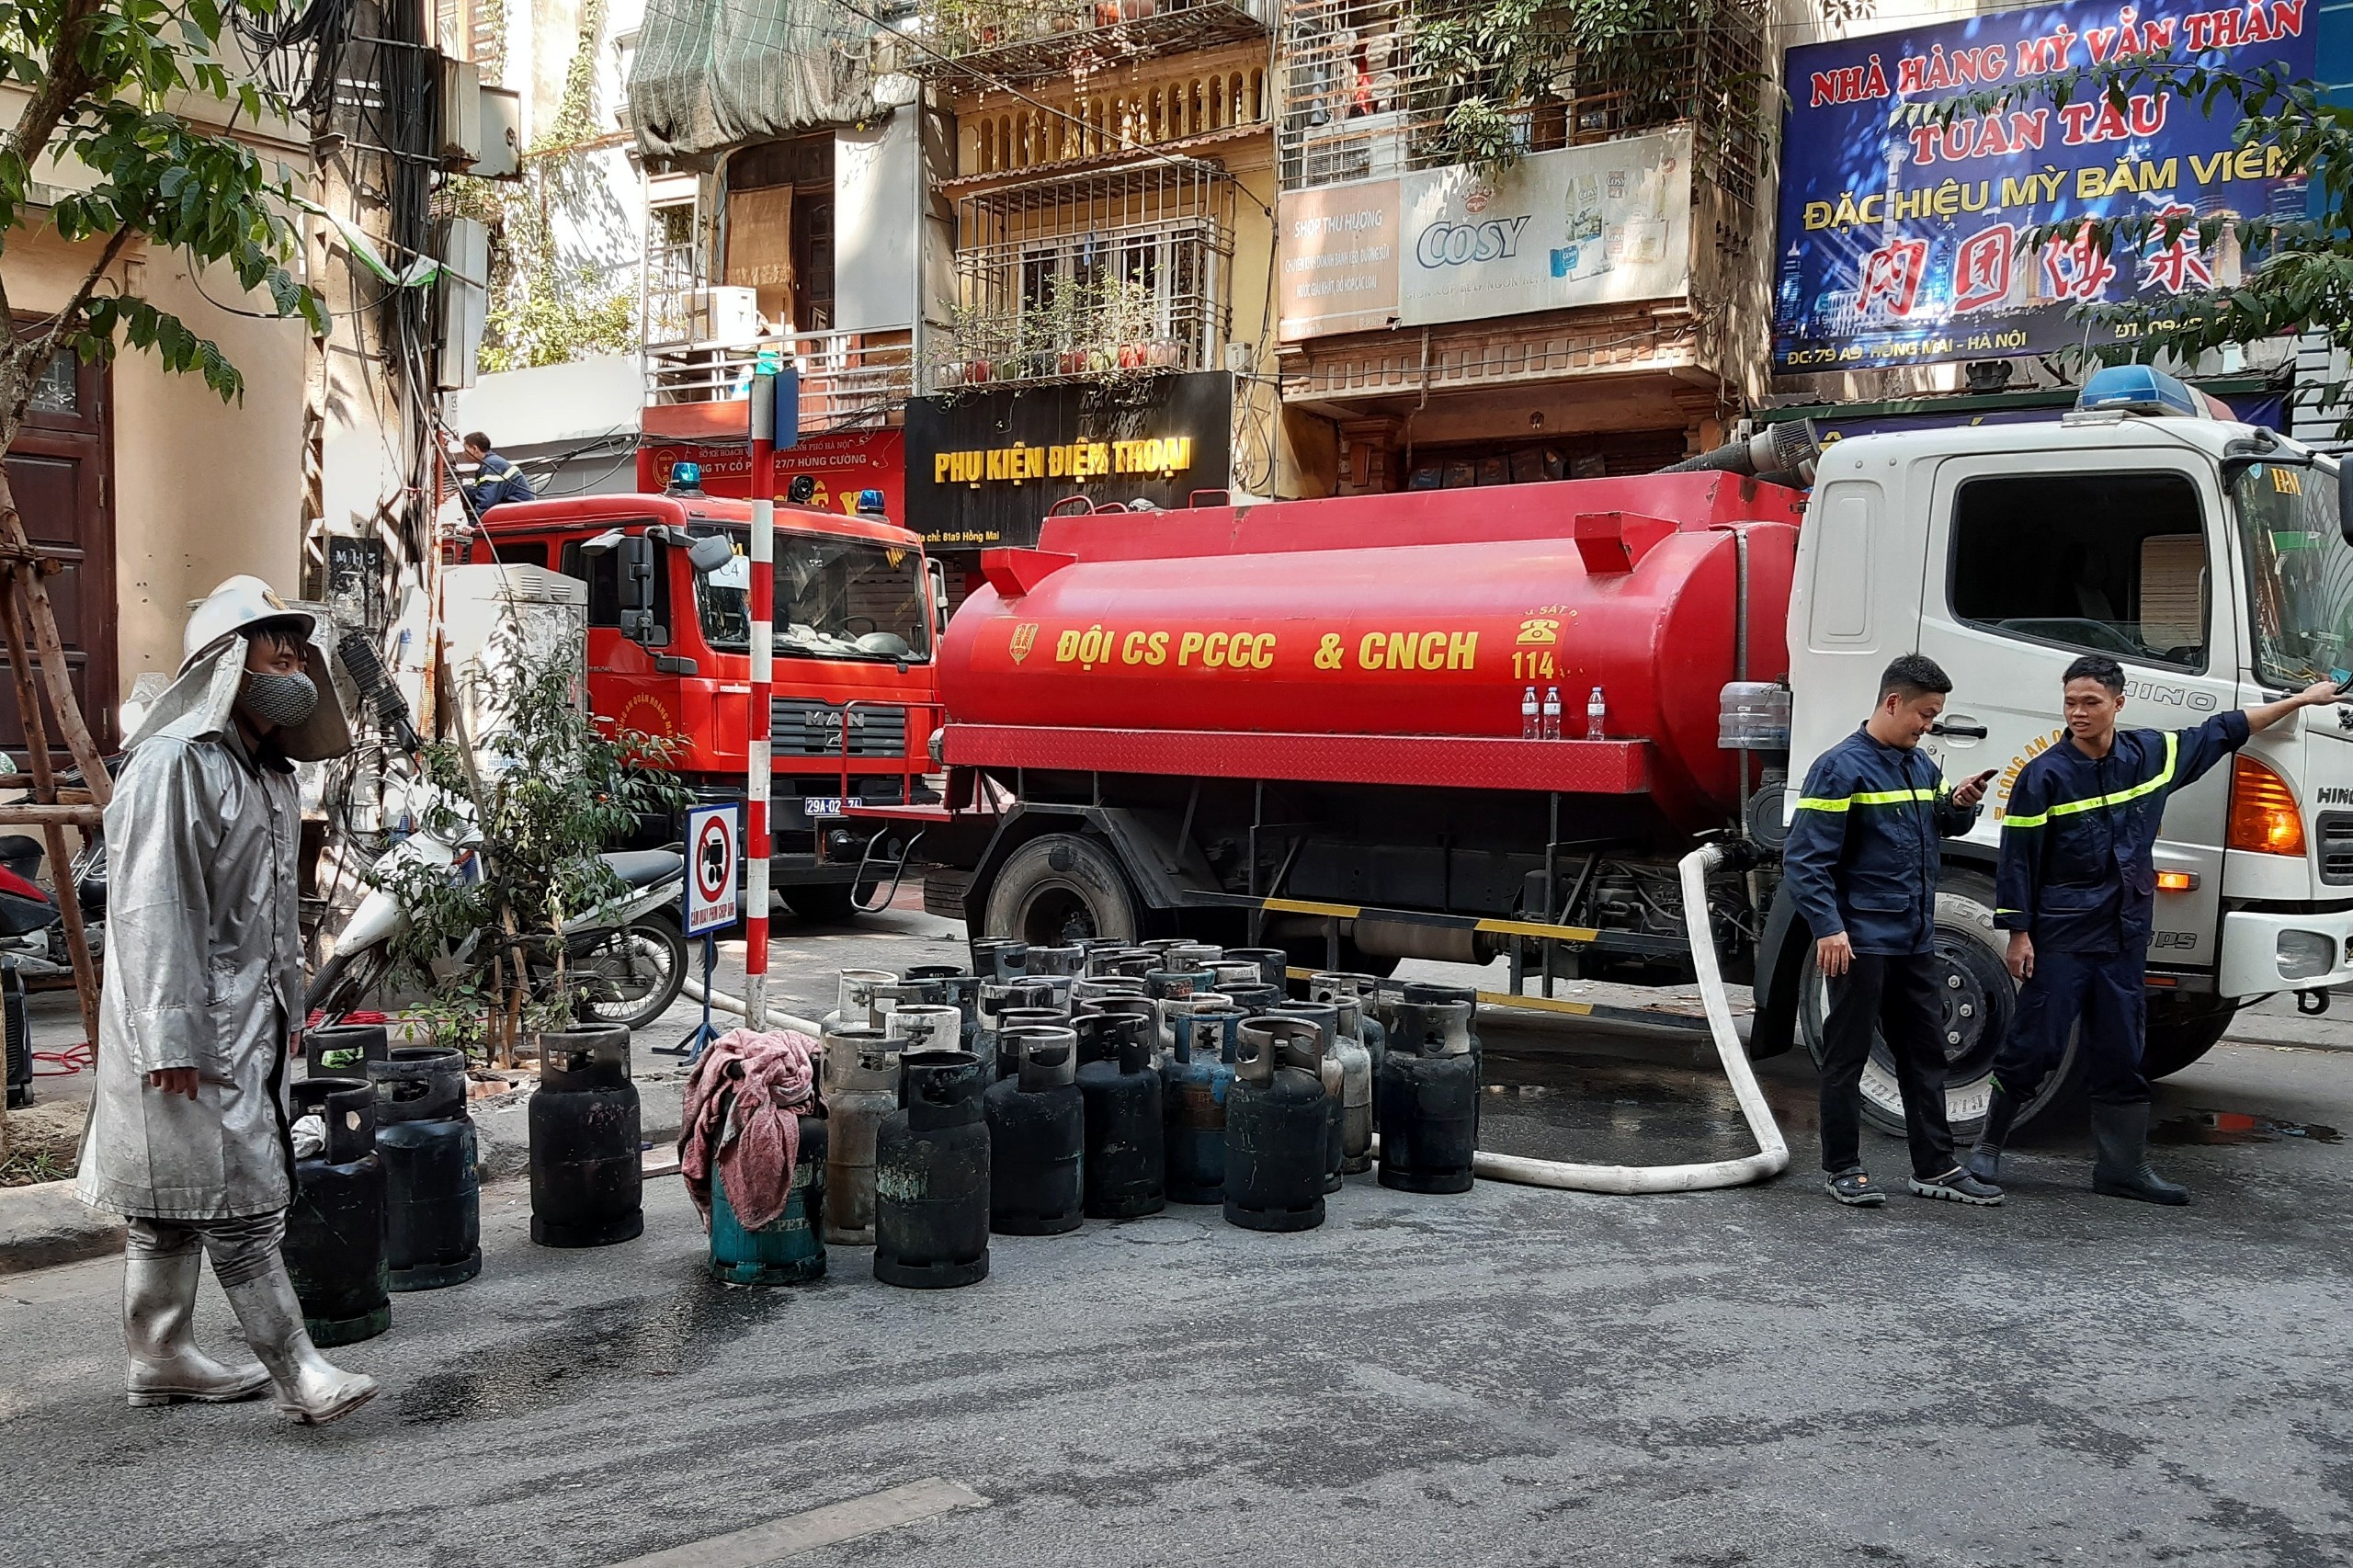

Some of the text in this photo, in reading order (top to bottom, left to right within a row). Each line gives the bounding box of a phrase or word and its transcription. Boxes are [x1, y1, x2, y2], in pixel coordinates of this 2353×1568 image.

[1810, 53, 1890, 108] NHÀ
[1897, 43, 2008, 94] HÀNG
[1802, 190, 1885, 235] ĐẶC
[1893, 177, 1991, 222] HIỆU
[1294, 216, 1322, 238] SHOP
[1322, 215, 1343, 234] THU
[1416, 215, 1532, 269] COSY
[1967, 334, 1993, 351] HÀ
[1995, 329, 2028, 350] NỘI
[714, 462, 727, 472] TY
[775, 453, 868, 470] 27/7 HÙNG CƯỜNG
[935, 436, 1191, 490] PHỤ KIỆN ĐIỆN THOẠI
[1055, 624, 1480, 671] ĐỘI CS PCCC & CNCH
[1511, 651, 1554, 680] 114
[2122, 680, 2217, 712] HINO
[805, 710, 865, 727] MAN
[2023, 735, 2050, 759] AN
